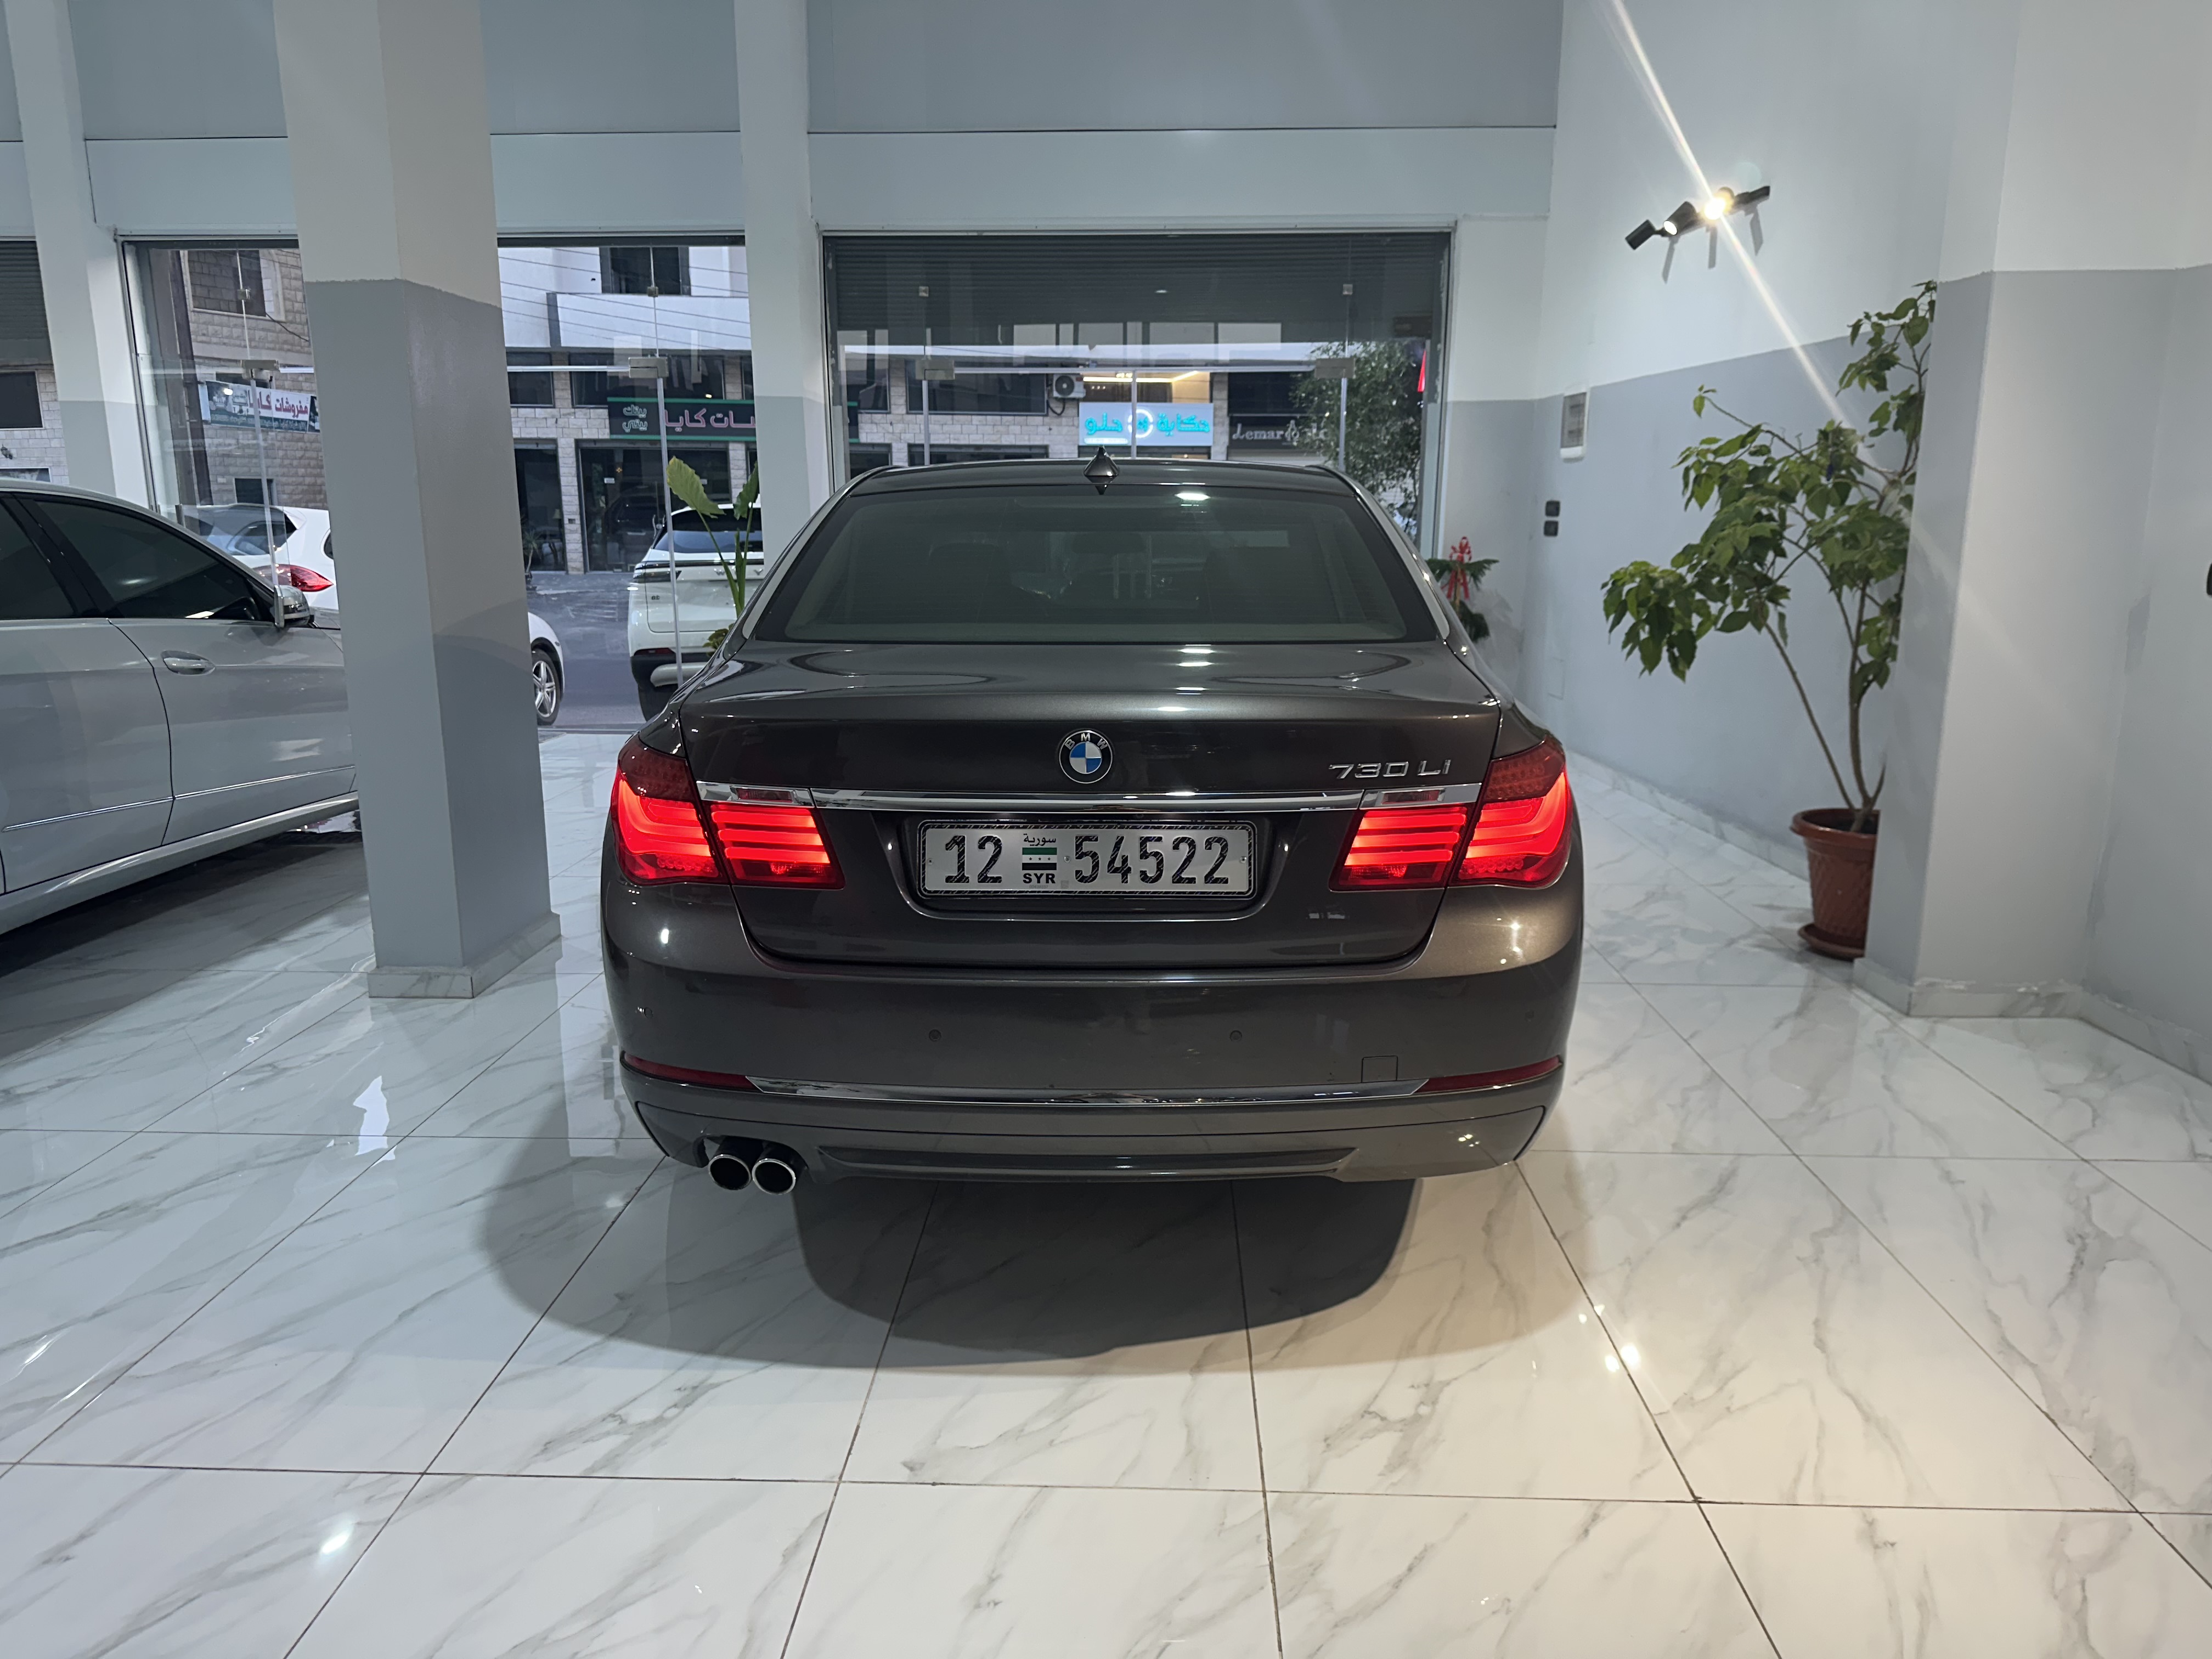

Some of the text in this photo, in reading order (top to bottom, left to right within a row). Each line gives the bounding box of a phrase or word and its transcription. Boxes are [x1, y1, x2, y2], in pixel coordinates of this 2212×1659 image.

[275, 396, 308, 419] مفروشات
[1085, 412, 1210, 437] حكاية حلو
[1232, 423, 1284, 440] Lemar
[1064, 732, 1108, 750] BMW
[1328, 761, 1409, 779] 730
[1023, 833, 1057, 847] سورية
[945, 834, 1229, 884] 12 54522
[1023, 873, 1056, 884] SYR
